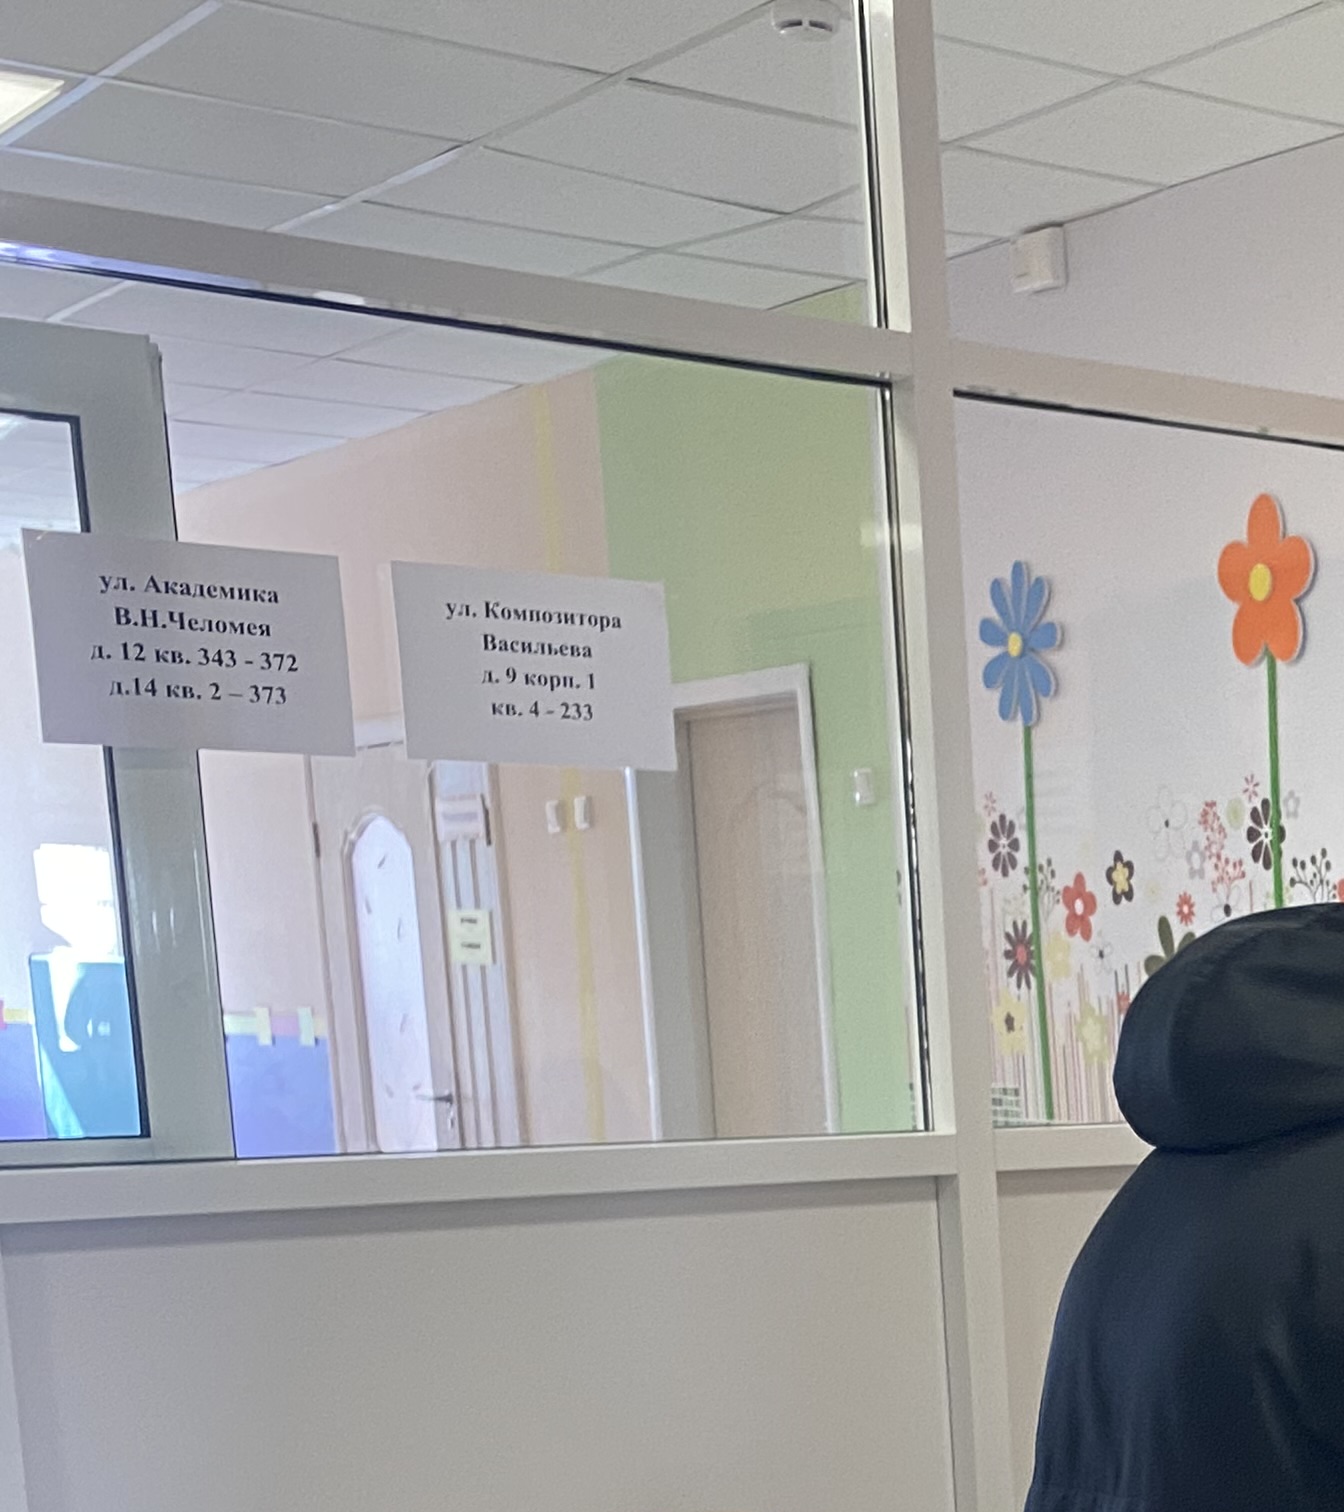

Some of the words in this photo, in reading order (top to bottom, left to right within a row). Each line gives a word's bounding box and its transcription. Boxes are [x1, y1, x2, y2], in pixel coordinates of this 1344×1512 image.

[98, 571, 137, 596] ул.
[143, 574, 280, 605] Академика
[113, 605, 272, 638] В.Н.Челомея
[445, 601, 478, 621] ул.
[483, 599, 623, 634] Композитора
[89, 643, 113, 662] д.
[120, 640, 147, 663] 12
[153, 648, 192, 666] кв.
[196, 646, 238, 669] 343
[259, 651, 300, 674] 372
[482, 632, 593, 659] Васильева
[108, 676, 159, 698] д.14
[165, 683, 203, 701] кв.
[208, 681, 223, 702] 2
[248, 683, 288, 706] 373
[480, 669, 501, 685] д.
[504, 666, 518, 685] 9
[523, 672, 582, 693] корп.
[587, 672, 596, 691] 1
[490, 701, 524, 718] кв.
[528, 699, 541, 719] 4
[559, 700, 594, 722] 233
